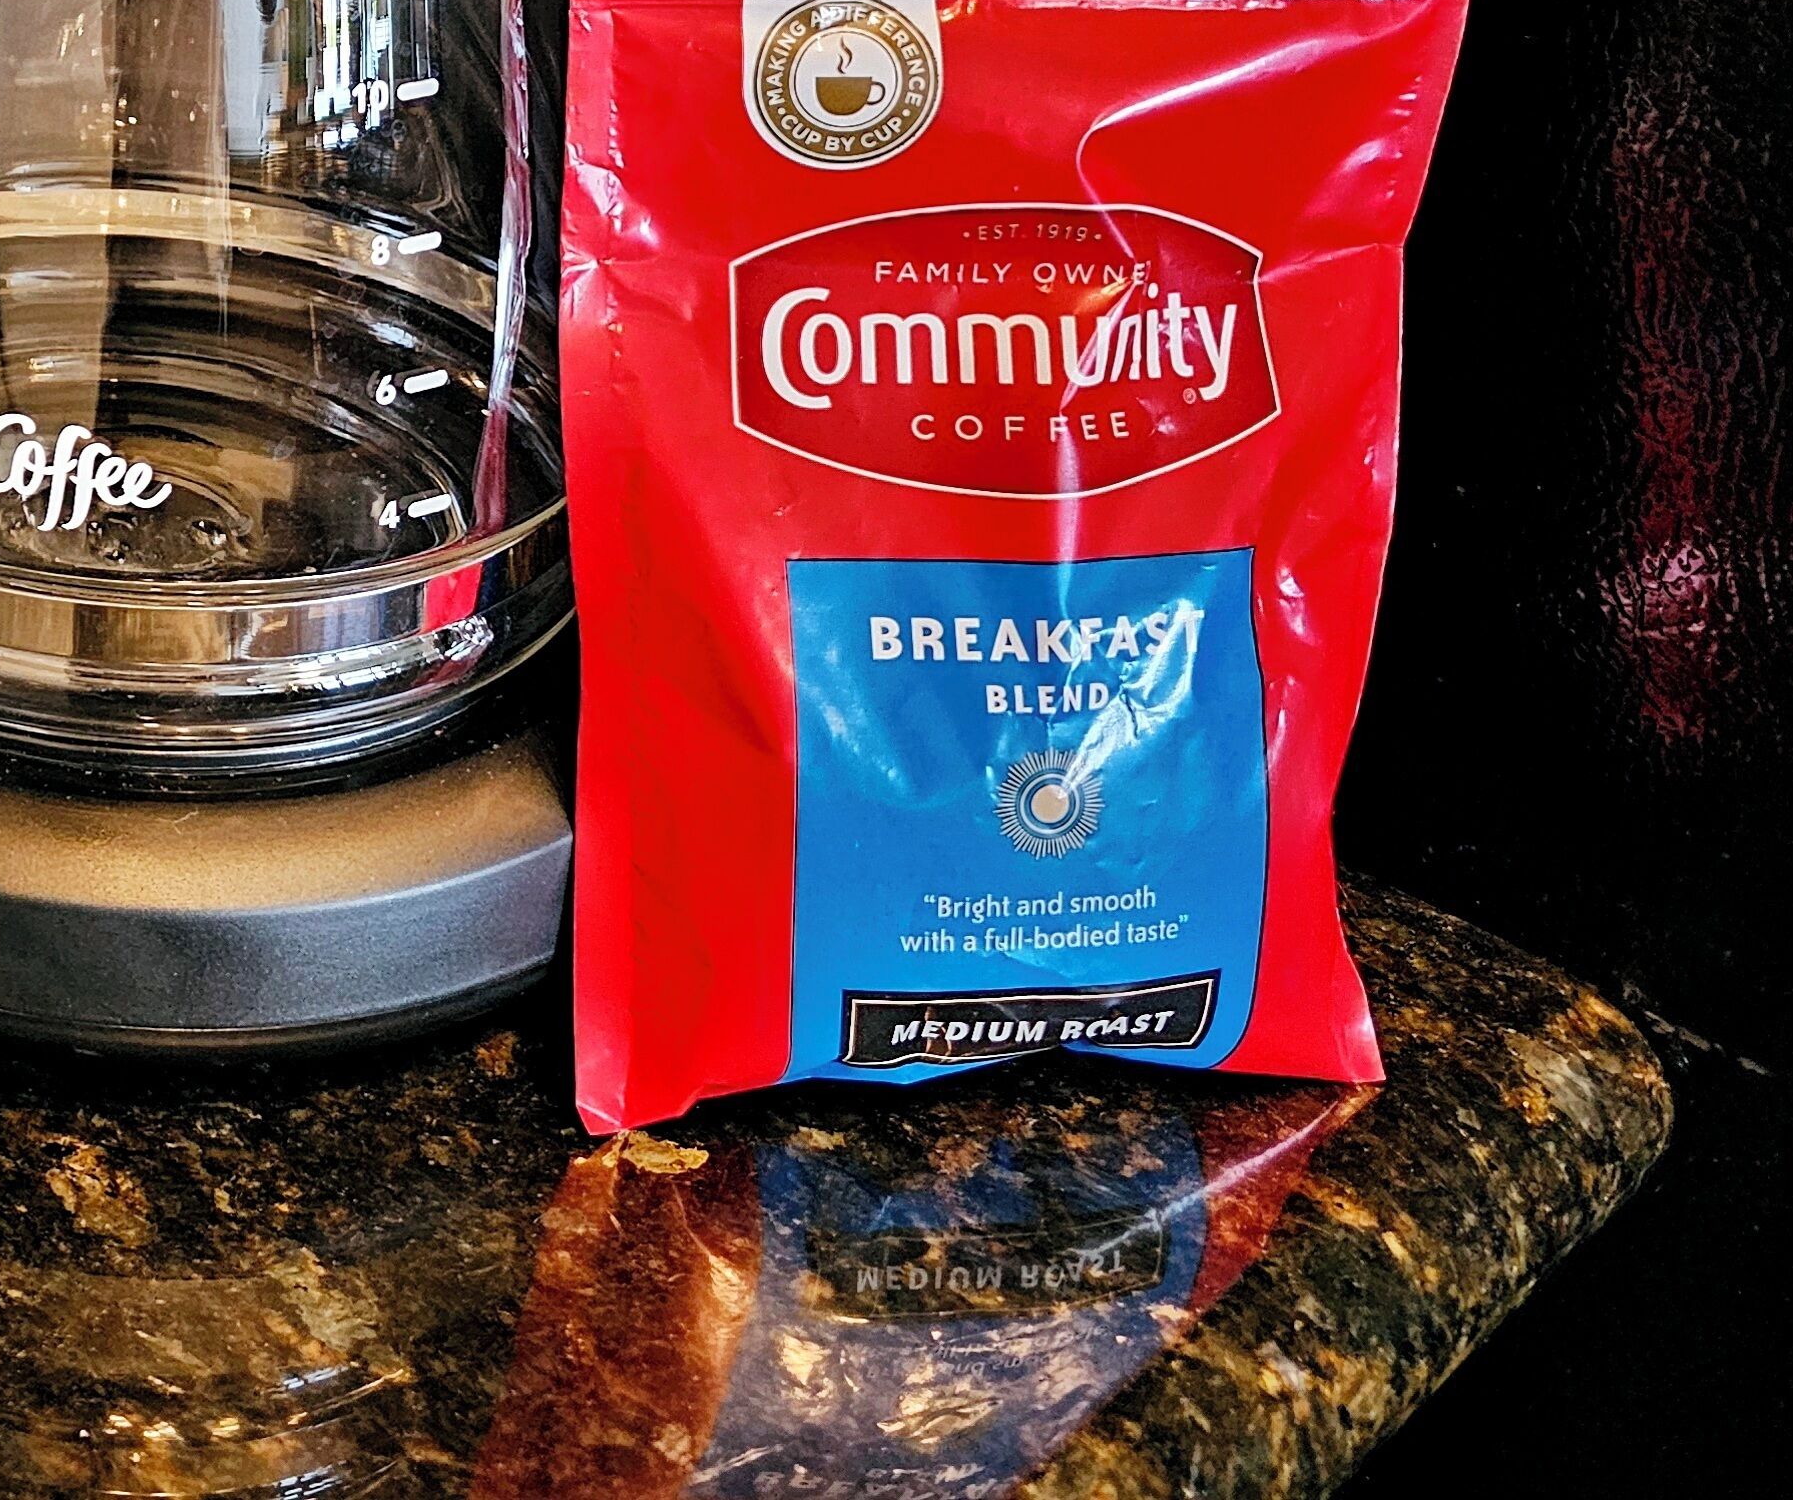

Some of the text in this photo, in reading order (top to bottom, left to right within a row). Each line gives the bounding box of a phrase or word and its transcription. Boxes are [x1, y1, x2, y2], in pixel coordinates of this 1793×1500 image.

[764, 19, 808, 107] MAKING
[351, 79, 389, 113] 10
[780, 113, 903, 152] CUP BY CUP
[1035, 222, 1089, 243] 1919
[370, 234, 390, 266] 8
[875, 260, 1152, 286] FAMILY OWNE
[760, 280, 1238, 410] Community
[374, 373, 397, 406] 6
[910, 410, 1130, 442] COFFEE
[378, 499, 400, 529] 4
[869, 608, 1205, 663] BREAKFAST
[985, 682, 1110, 715] BLEND
[1016, 891, 1064, 918] and
[1069, 884, 1157, 914] smooth
[899, 928, 955, 953] with
[962, 934, 977, 952] a
[984, 921, 1121, 952] full-bodied
[891, 1010, 1176, 1047] MEDIUM ROAST
